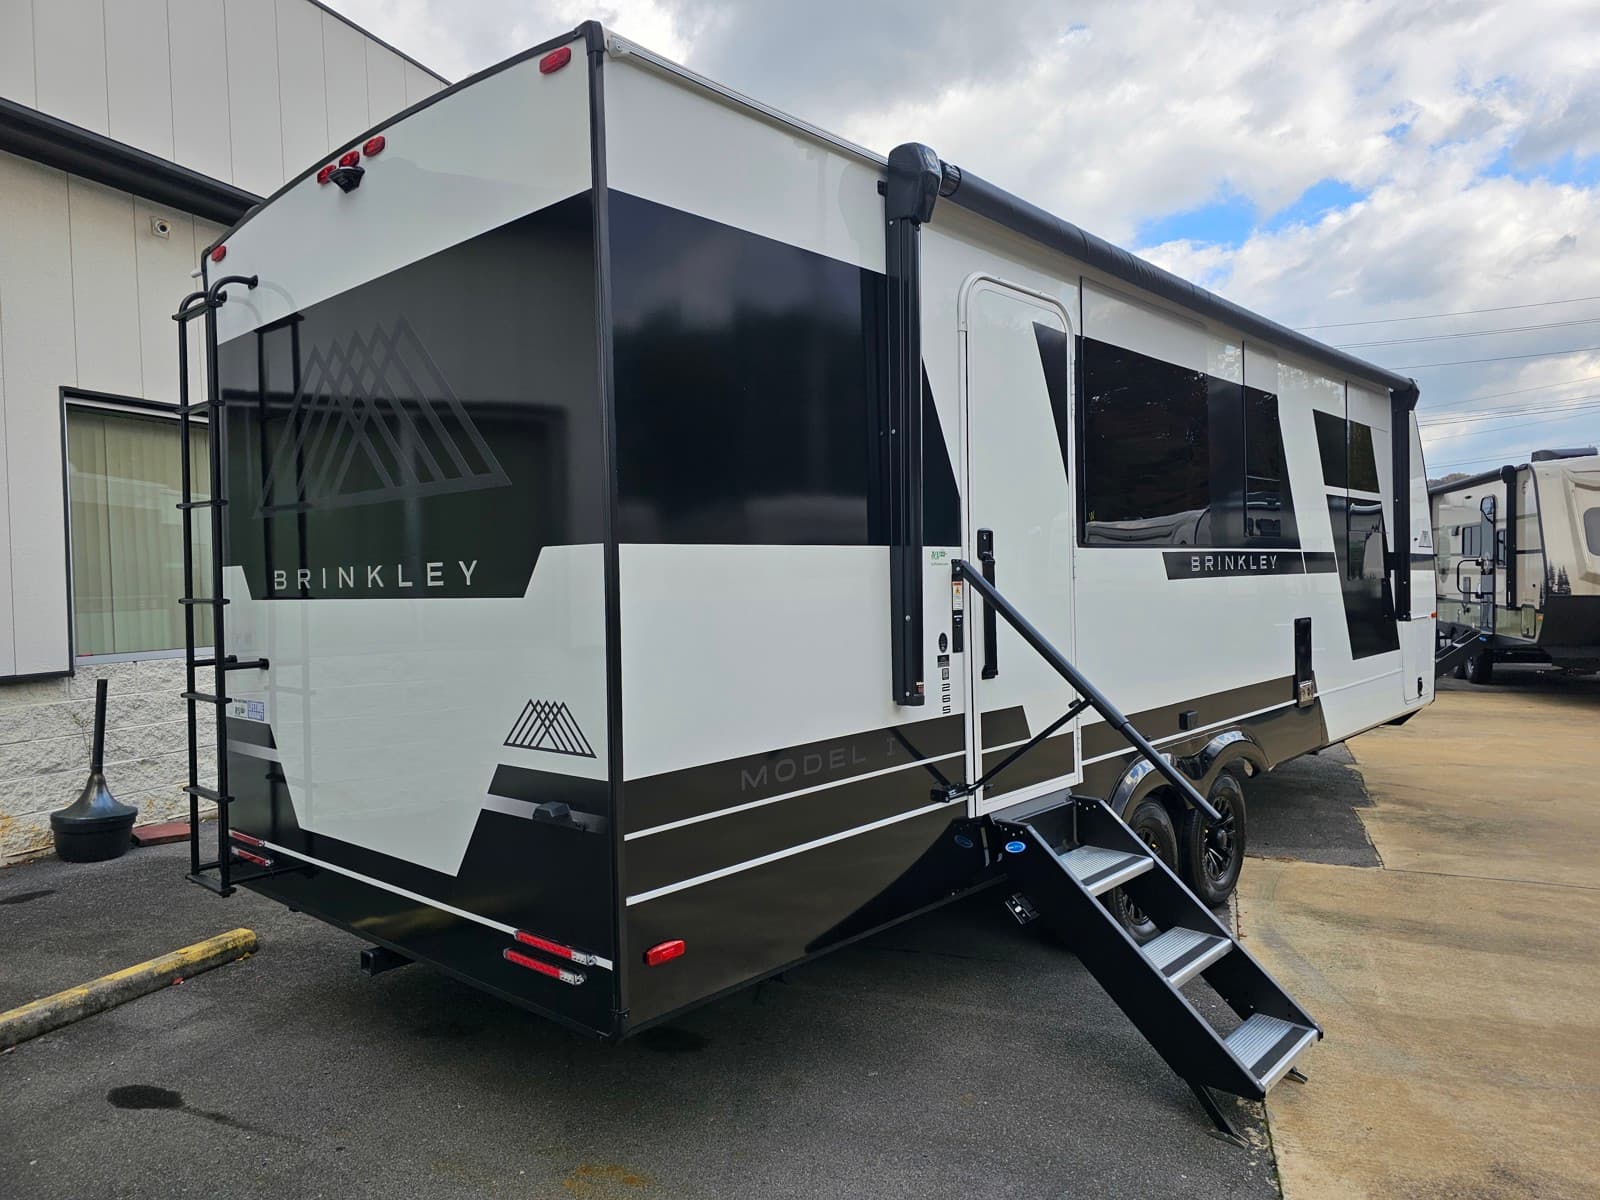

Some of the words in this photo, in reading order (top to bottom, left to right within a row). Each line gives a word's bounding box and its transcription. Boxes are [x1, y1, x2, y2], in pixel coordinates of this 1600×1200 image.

[274, 560, 478, 590] BRINKLEY
[1191, 555, 1277, 572] BRINKLEY
[941, 683, 951, 714] 265
[740, 745, 867, 791] MODEL
